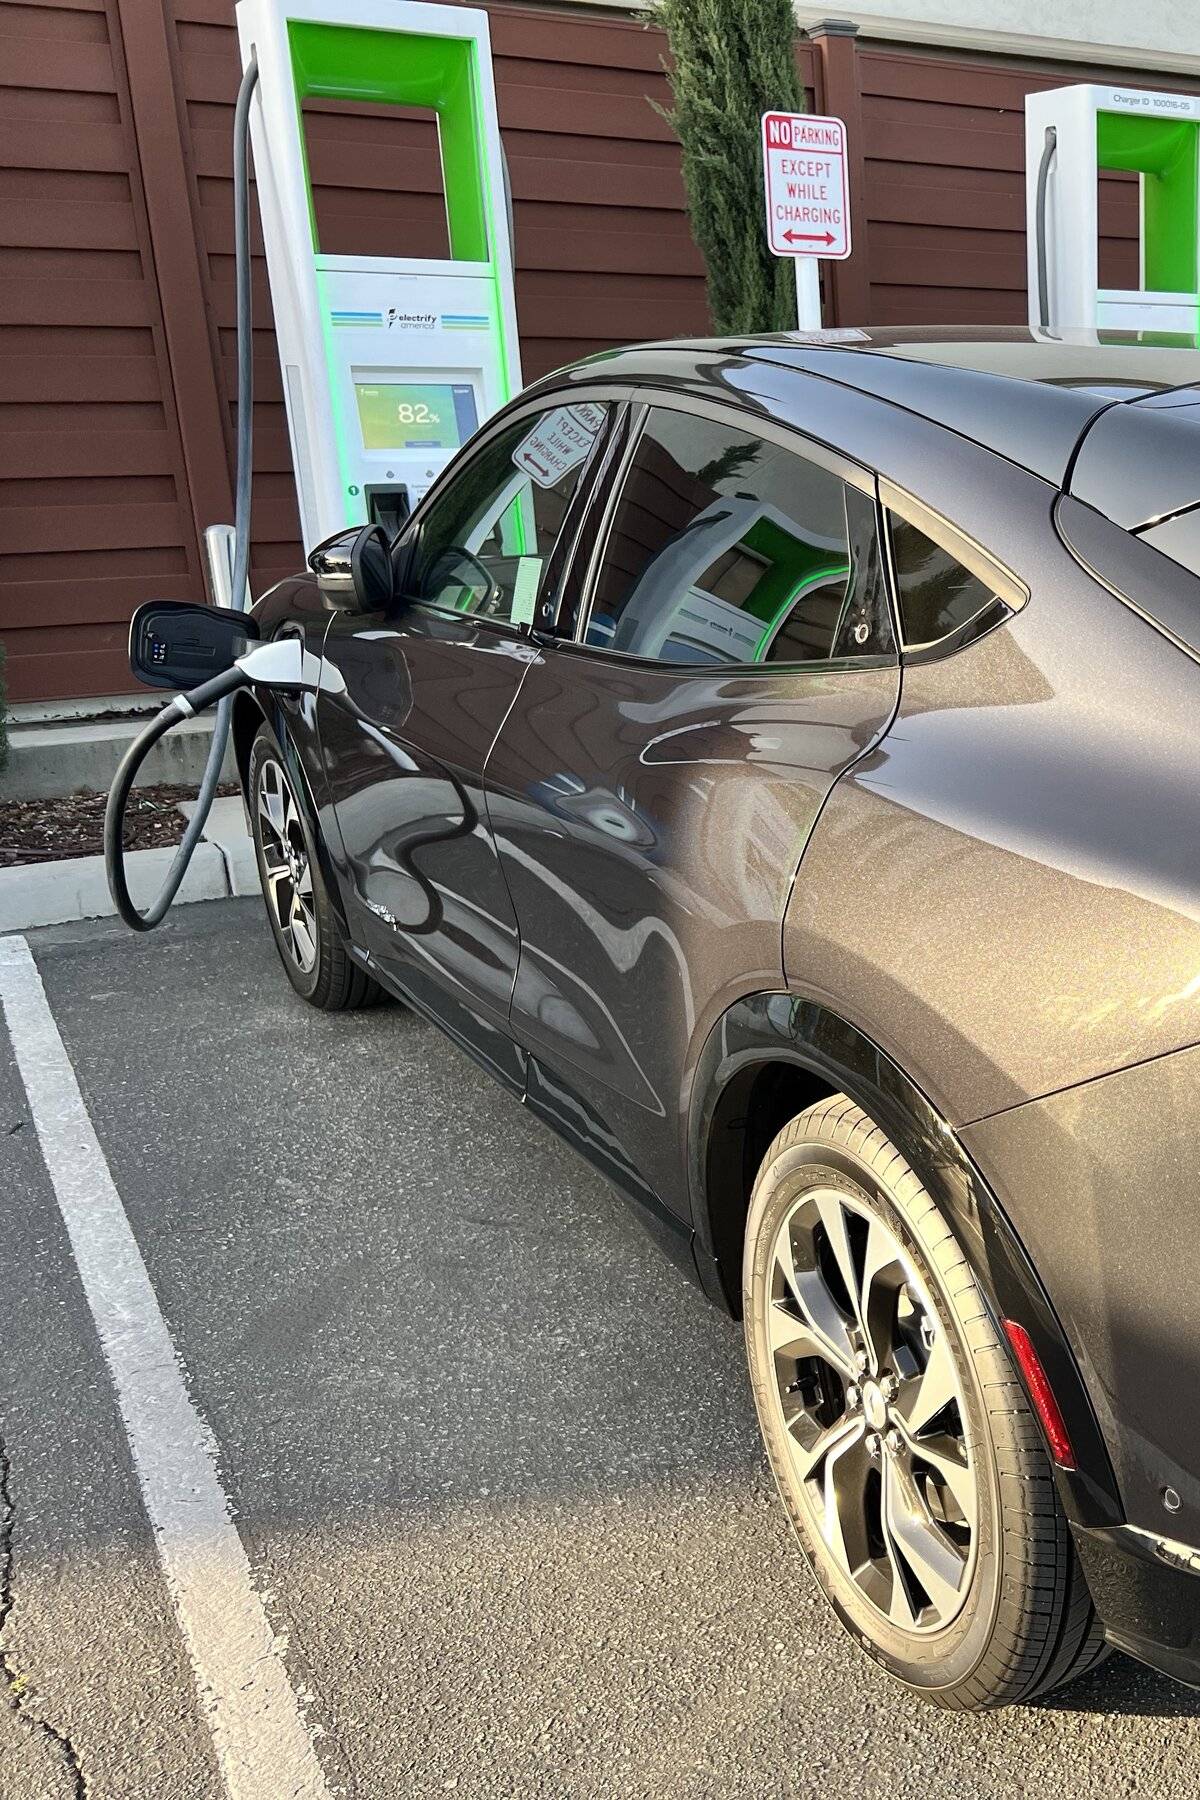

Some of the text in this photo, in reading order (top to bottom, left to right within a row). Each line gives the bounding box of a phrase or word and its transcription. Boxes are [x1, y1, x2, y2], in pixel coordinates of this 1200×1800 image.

[1113, 94, 1140, 106] Charger
[769, 119, 839, 146] NO PARKING
[781, 159, 832, 178] EXCEPT
[787, 183, 828, 201] WHILE
[776, 204, 841, 224] CHARGING
[398, 314, 436, 324] electrify
[400, 322, 435, 330] america
[398, 403, 440, 424] 82%
